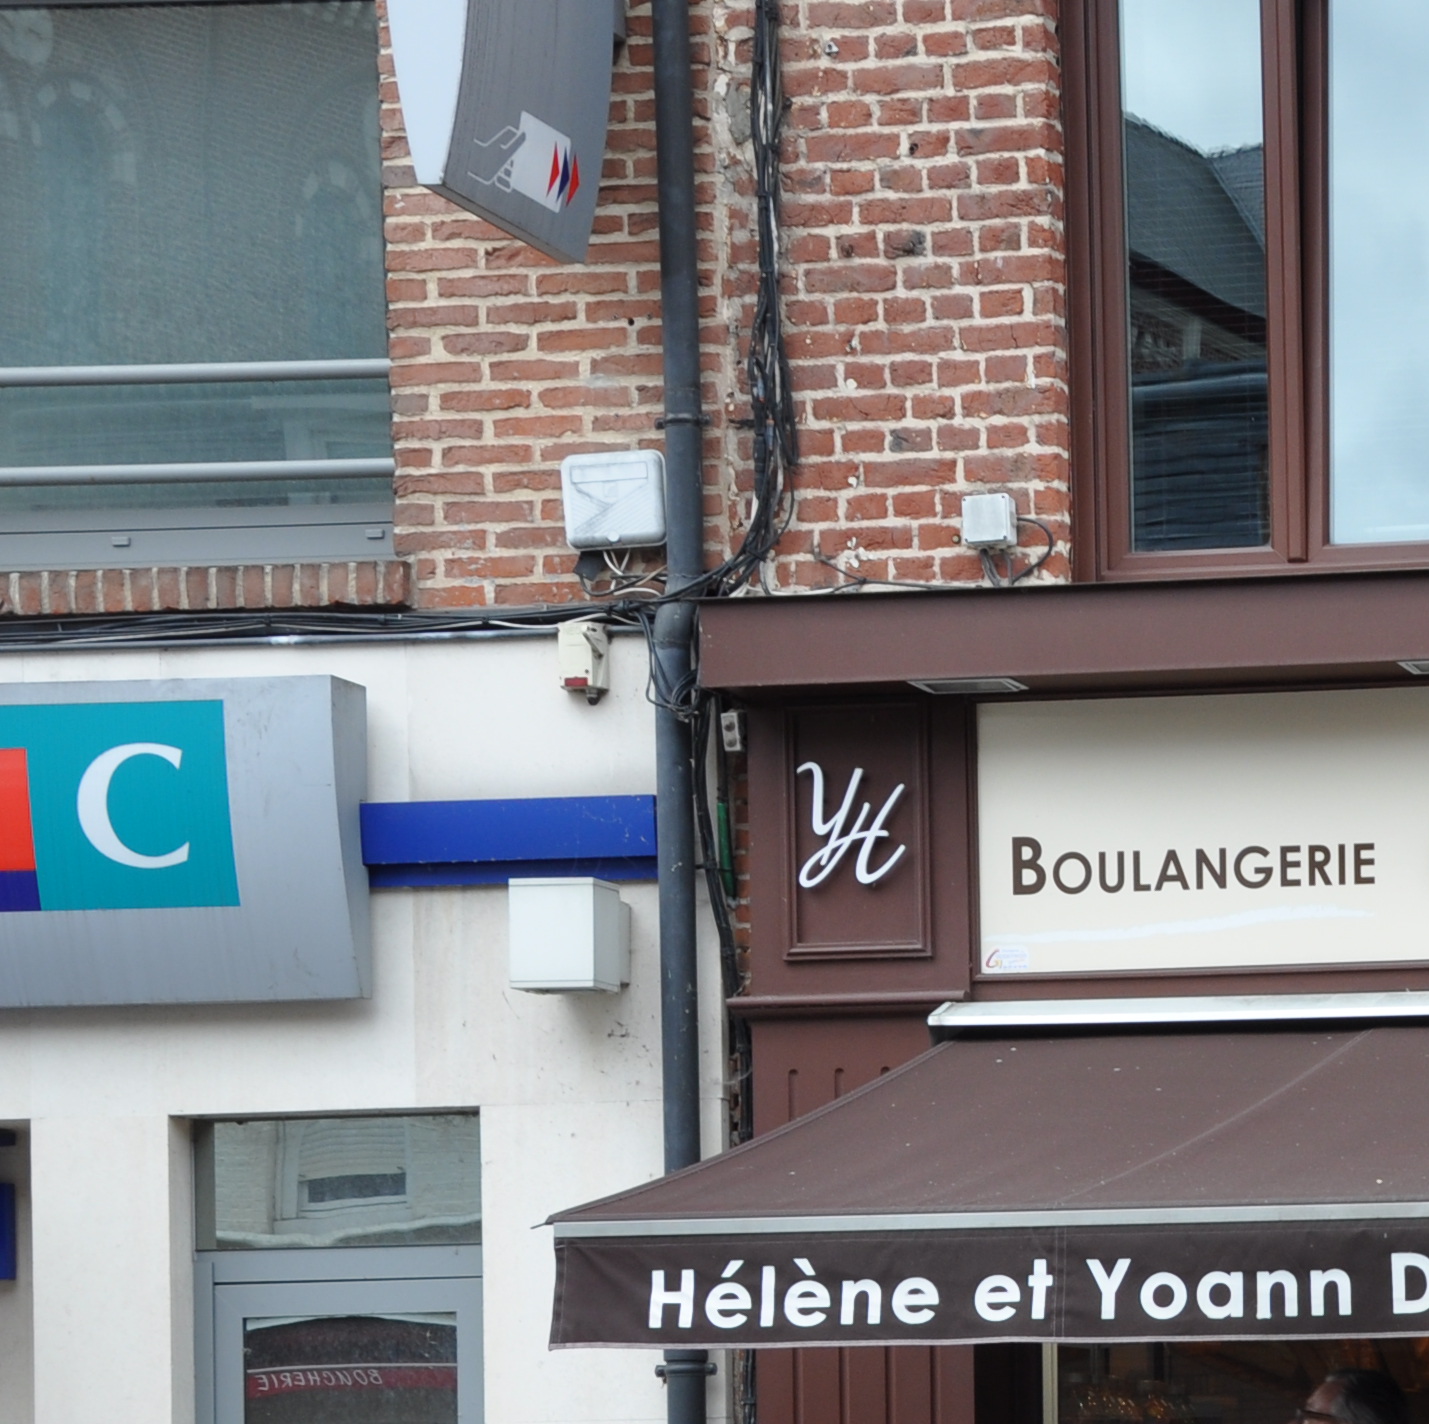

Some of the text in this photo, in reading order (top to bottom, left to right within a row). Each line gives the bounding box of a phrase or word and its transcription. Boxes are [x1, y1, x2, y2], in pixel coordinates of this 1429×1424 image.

[77, 742, 190, 869] C
[795, 760, 907, 889] YH
[1011, 835, 1376, 897] BOULANGERIE
[647, 1257, 941, 1331] Hélène
[973, 1258, 1055, 1323] et
[1085, 1257, 1353, 1322] Yoann
